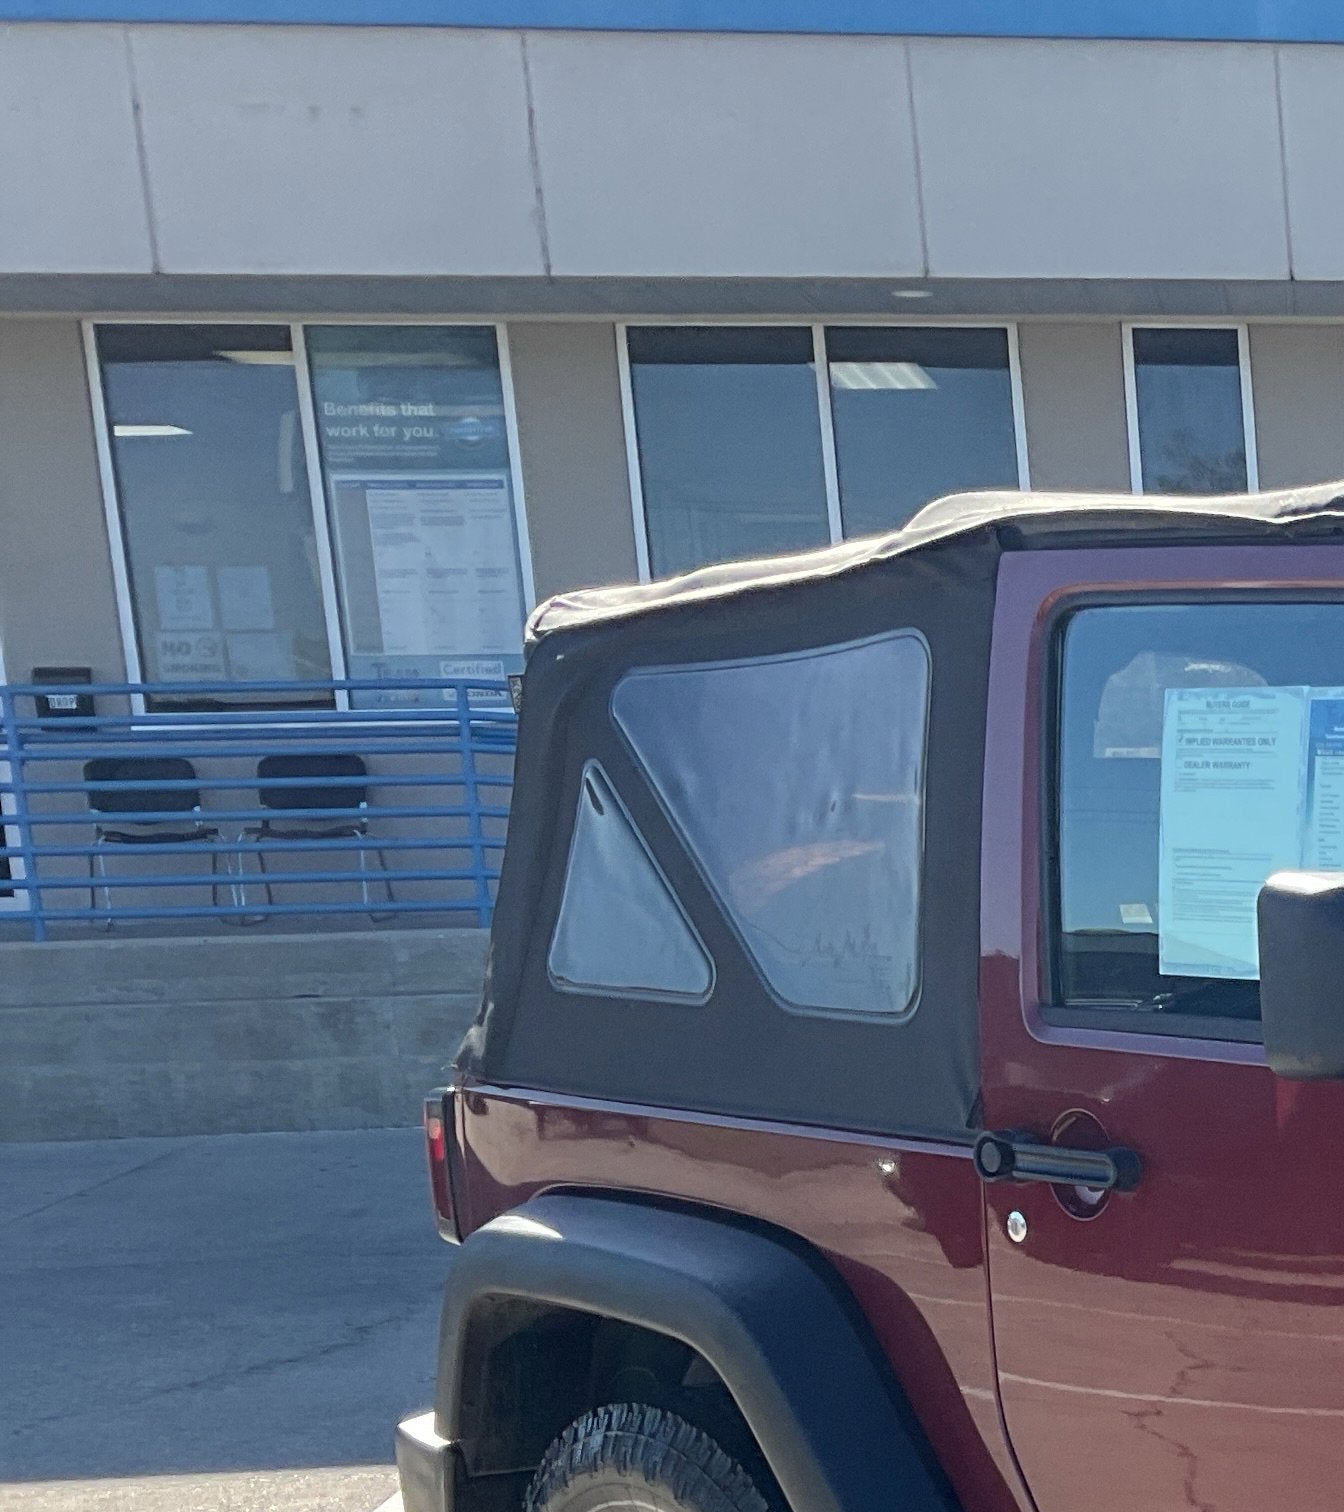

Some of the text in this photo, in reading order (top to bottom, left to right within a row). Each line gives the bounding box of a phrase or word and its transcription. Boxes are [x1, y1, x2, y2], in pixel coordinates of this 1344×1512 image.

[324, 401, 436, 416] Benefits that
[326, 424, 369, 437] work
[374, 423, 397, 437] for
[443, 663, 499, 675] Certified
[1212, 737, 1256, 747] WARRANTIES
[1257, 737, 1277, 747] ONLY
[1183, 760, 1251, 769] DEALER WARRANTY
